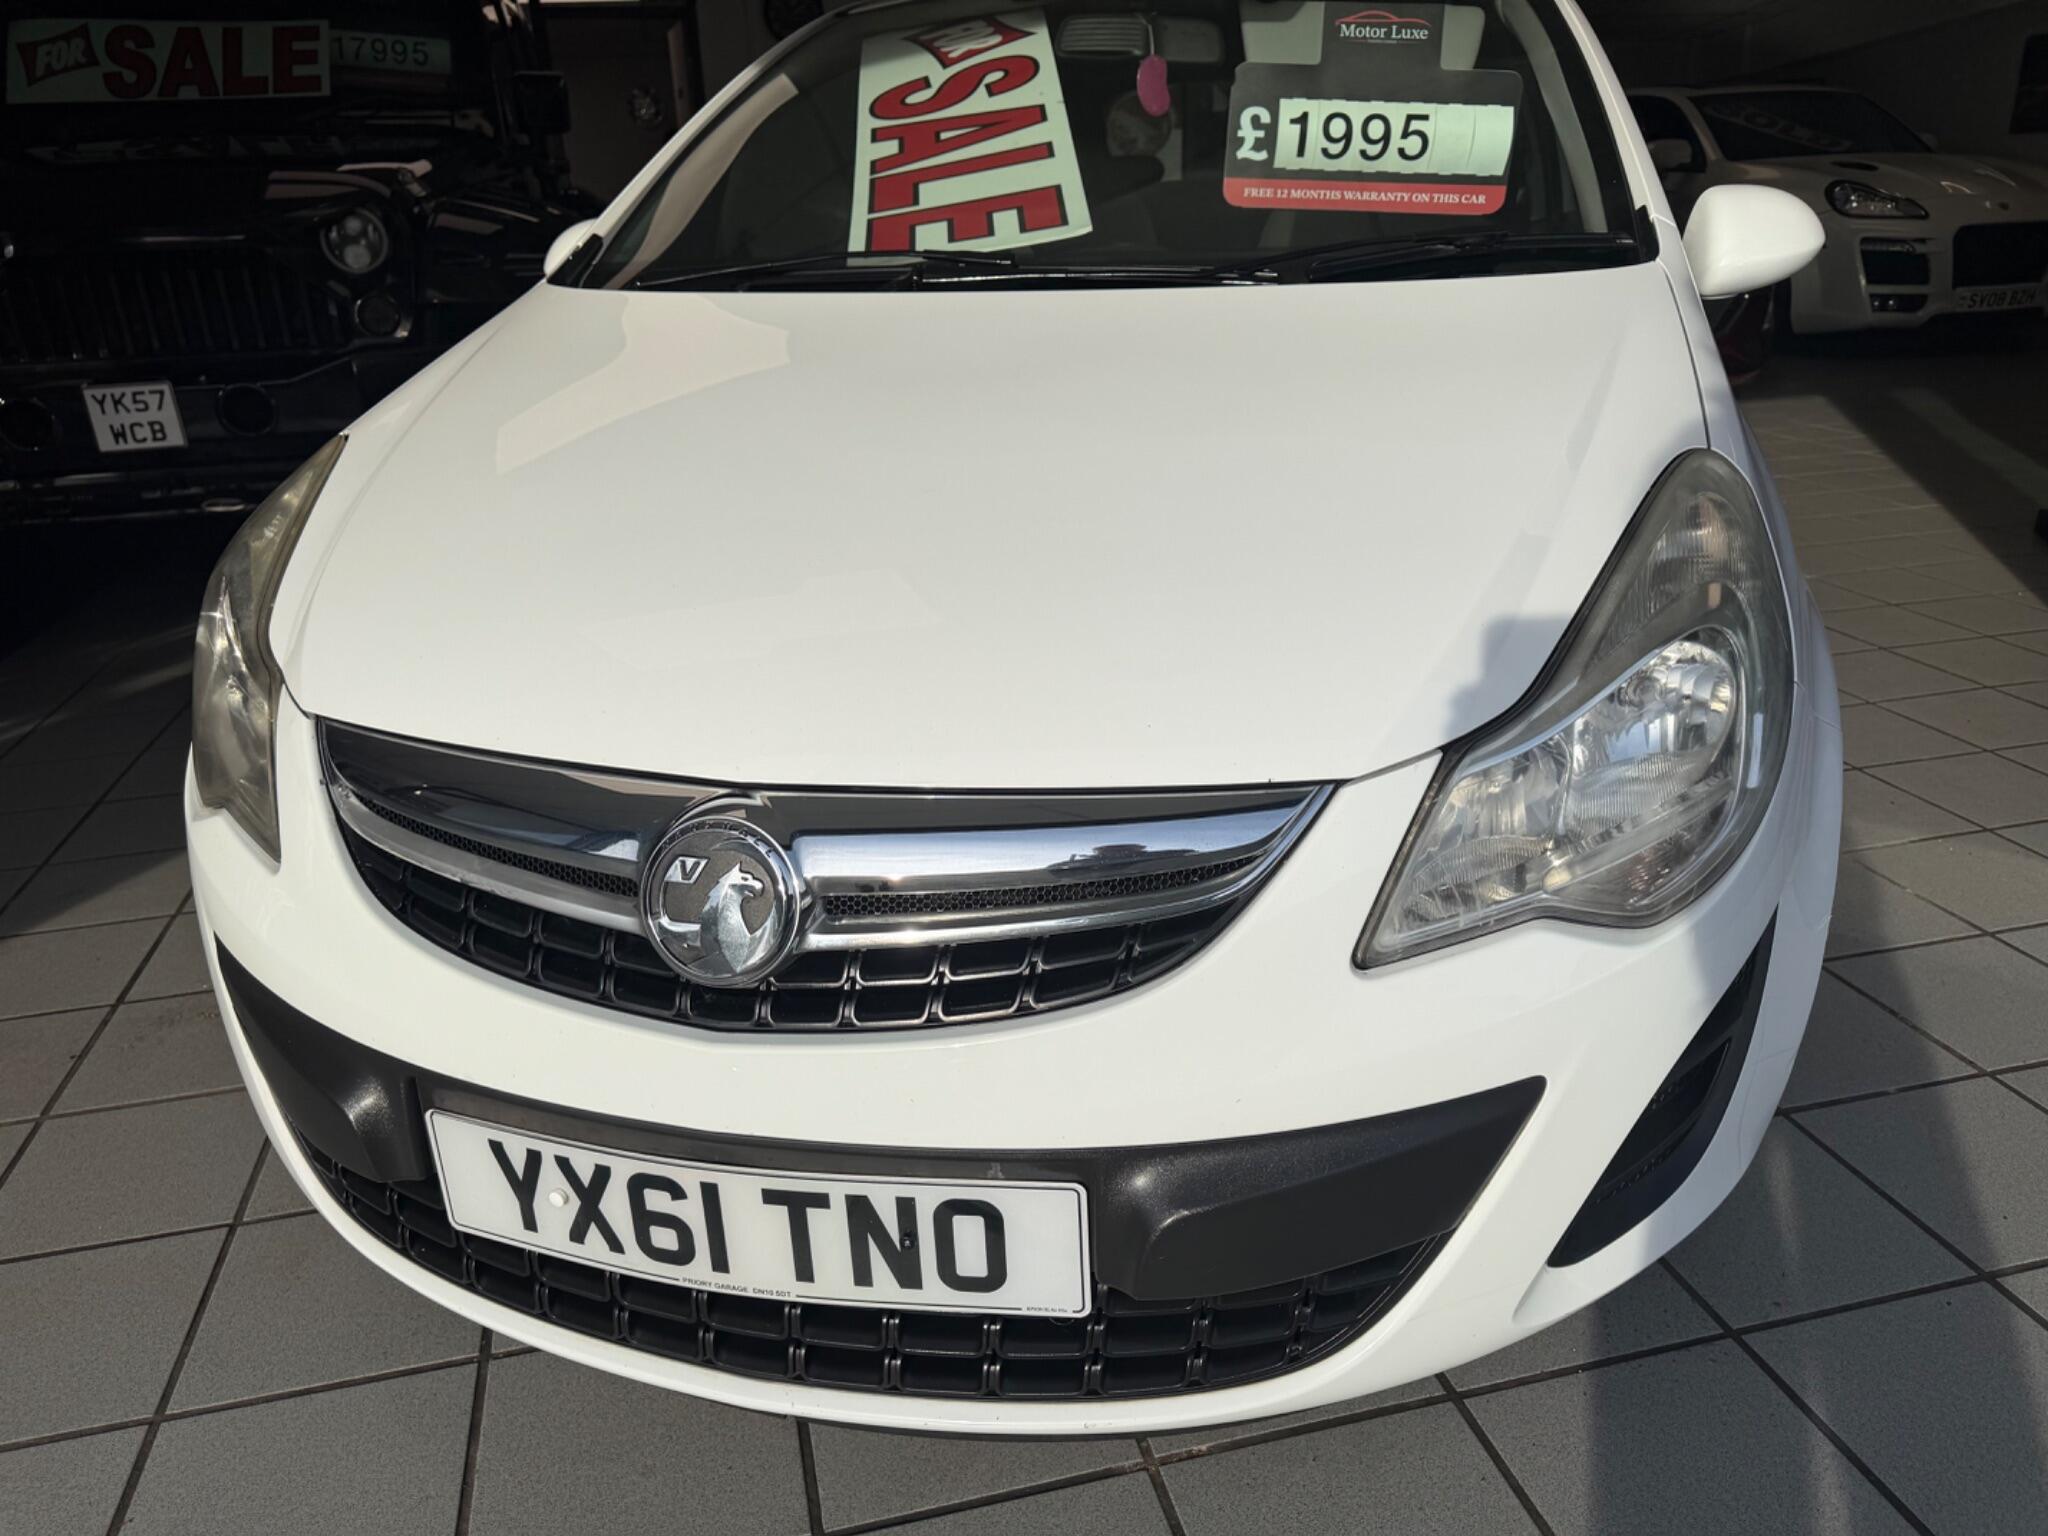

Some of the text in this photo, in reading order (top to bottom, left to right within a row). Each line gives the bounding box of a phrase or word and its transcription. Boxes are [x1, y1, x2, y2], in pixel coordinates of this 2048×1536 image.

[1340, 24, 1429, 40] Motor Luxe
[35, 24, 323, 99] FOR SALE
[331, 36, 429, 67] 17995
[867, 55, 1069, 252] SALE
[1243, 187, 1487, 205] FREE 12 MONTHS WARRANTY ON THIS CAR
[90, 389, 165, 415] YK57
[108, 420, 168, 445] WCB
[487, 1138, 1009, 1294] YX61 TNO
[682, 1276, 712, 1288] PRIORY
